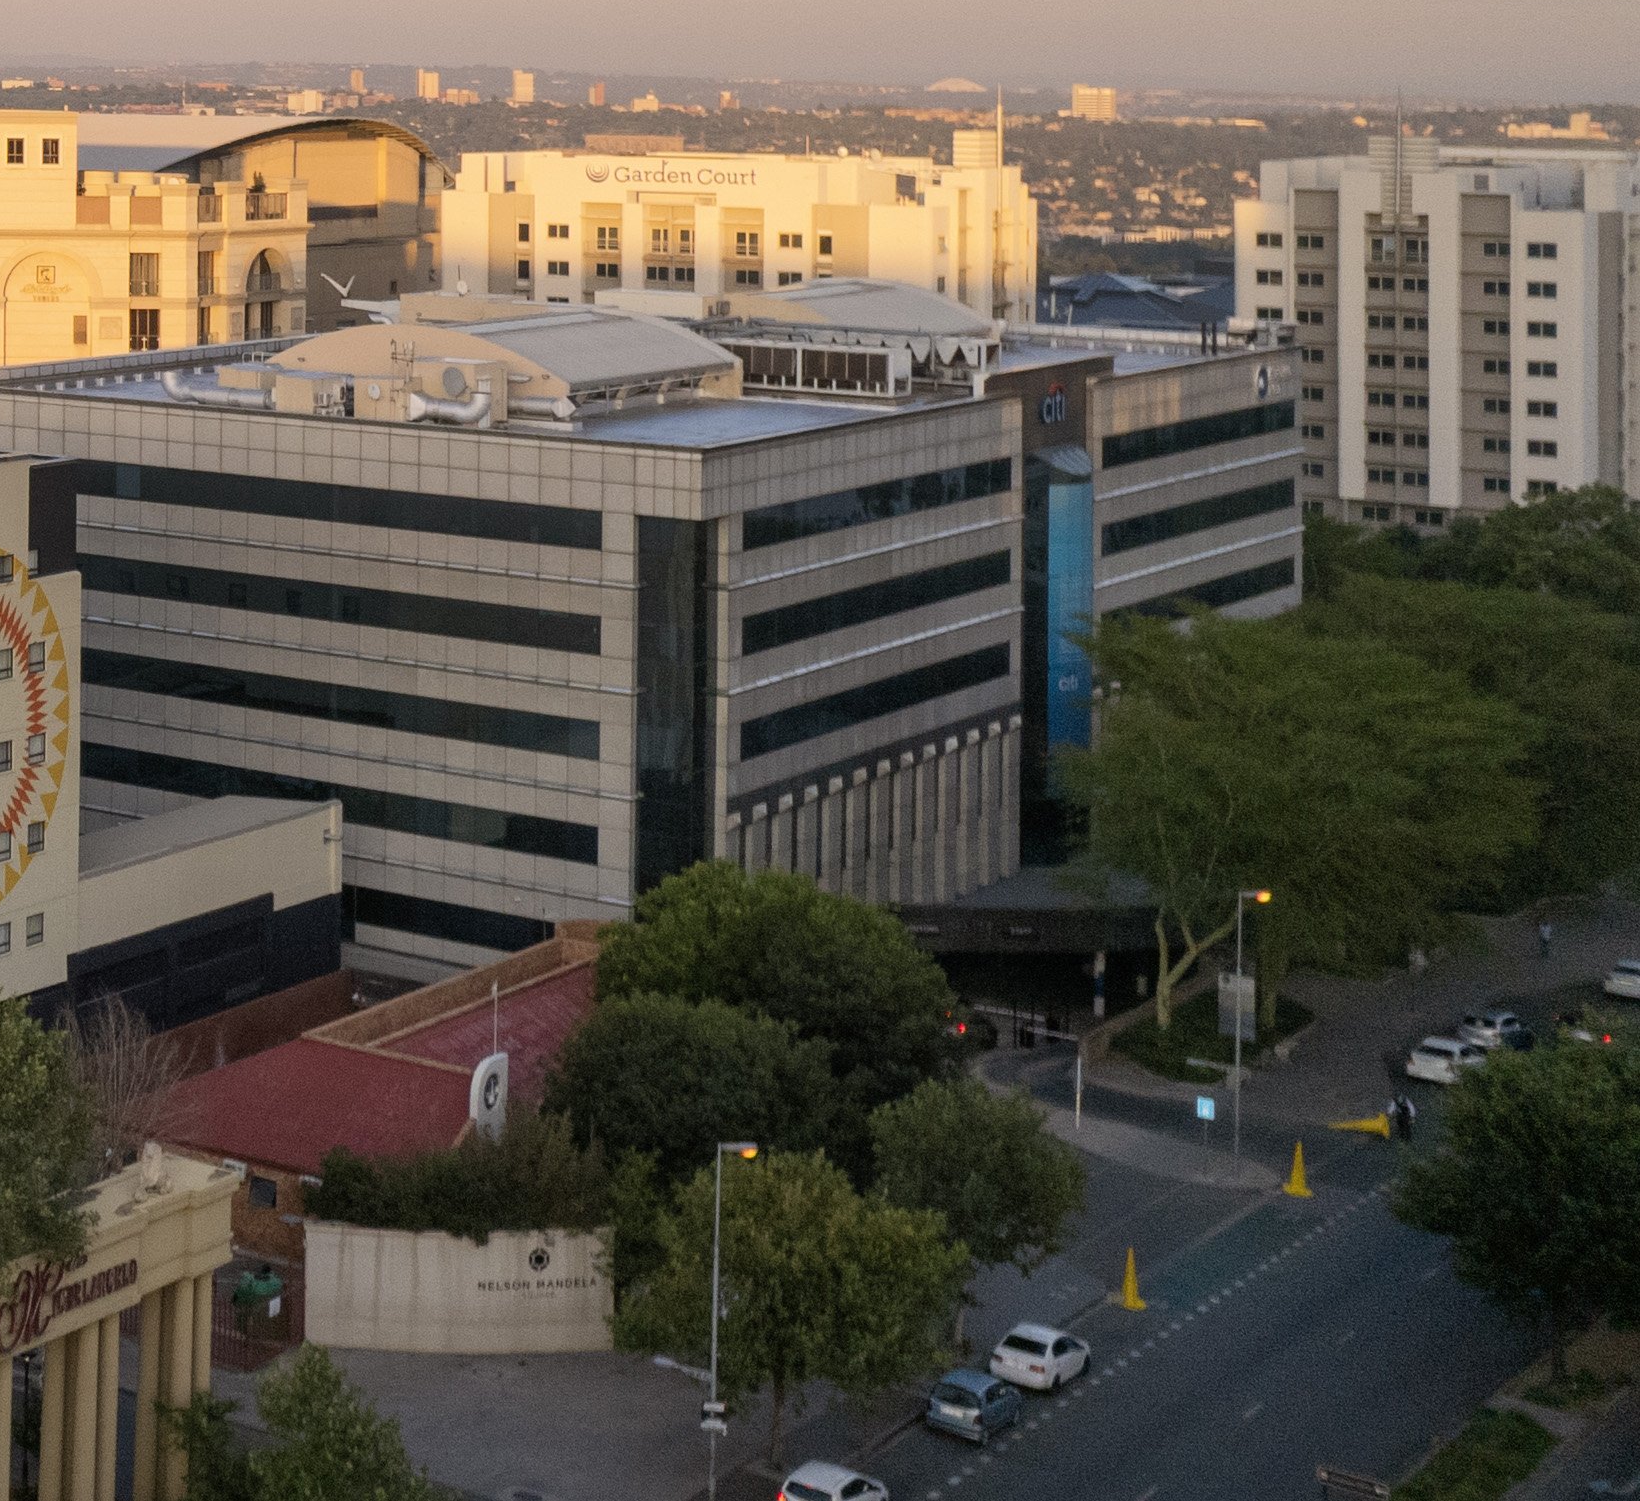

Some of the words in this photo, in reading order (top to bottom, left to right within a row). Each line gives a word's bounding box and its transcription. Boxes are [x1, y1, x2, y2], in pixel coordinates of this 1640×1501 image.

[614, 159, 693, 183] Garden
[697, 169, 757, 185] Court
[1042, 386, 1066, 423] citi
[477, 1281, 531, 1292] NELSON
[536, 1277, 597, 1290] MANDELA
